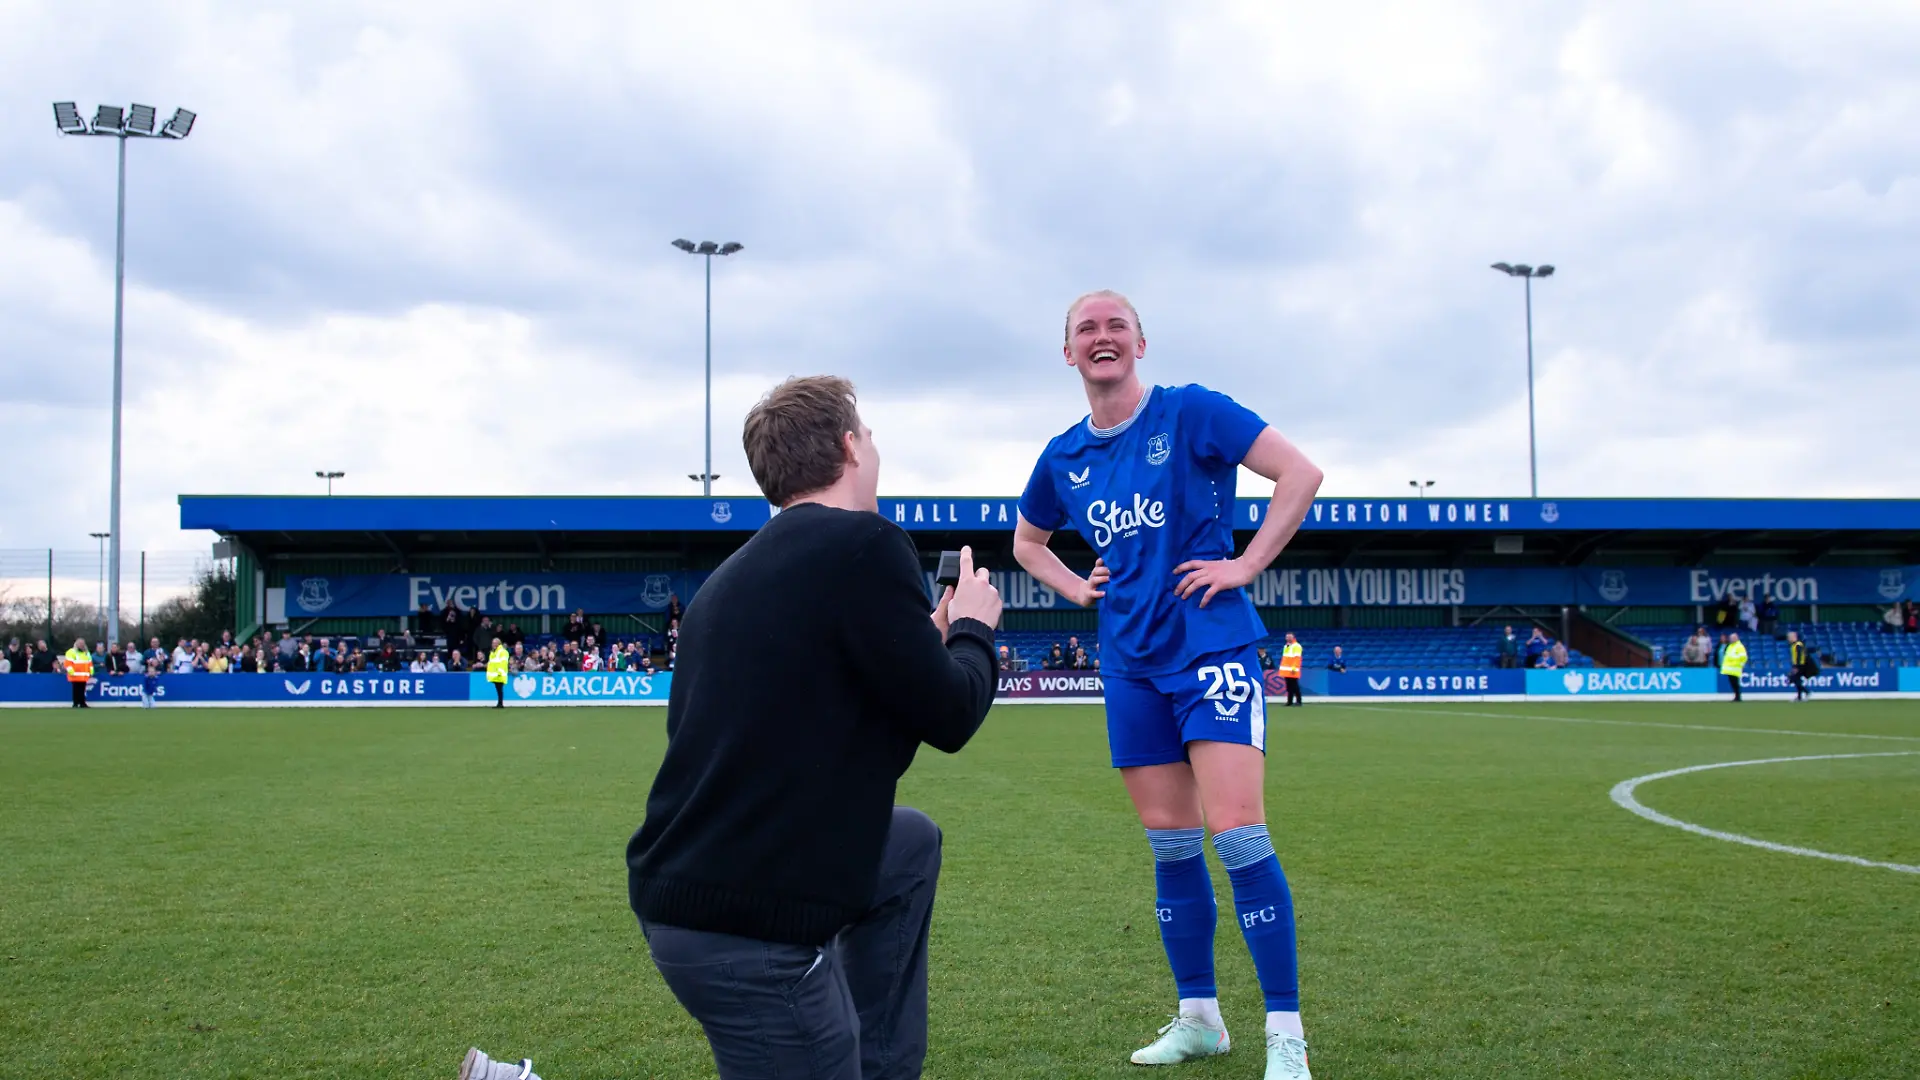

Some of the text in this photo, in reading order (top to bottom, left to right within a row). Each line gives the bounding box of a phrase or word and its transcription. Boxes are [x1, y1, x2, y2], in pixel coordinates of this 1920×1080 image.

[896, 503, 958, 523] HALL
[980, 503, 1020, 523] PA
[1302, 503, 1408, 523] VERTON
[1428, 503, 1510, 523] WOMEN
[1087, 492, 1166, 548] Stake
[409, 576, 566, 613] Everton
[1247, 569, 1465, 605] OME ON YOU BLUES
[1690, 569, 1819, 602] Everton
[100, 681, 165, 697] Fanats
[321, 678, 426, 695] CASTORE
[541, 676, 653, 696] BARCLAYS
[998, 677, 1032, 691] LAYS
[1197, 662, 1251, 703] 26
[1398, 675, 1489, 690] CASTORE
[1587, 671, 1682, 690] BARCLAYS
[1835, 671, 1880, 688] Ward
[1156, 908, 1172, 922] FC
[1242, 905, 1277, 929] EFC
